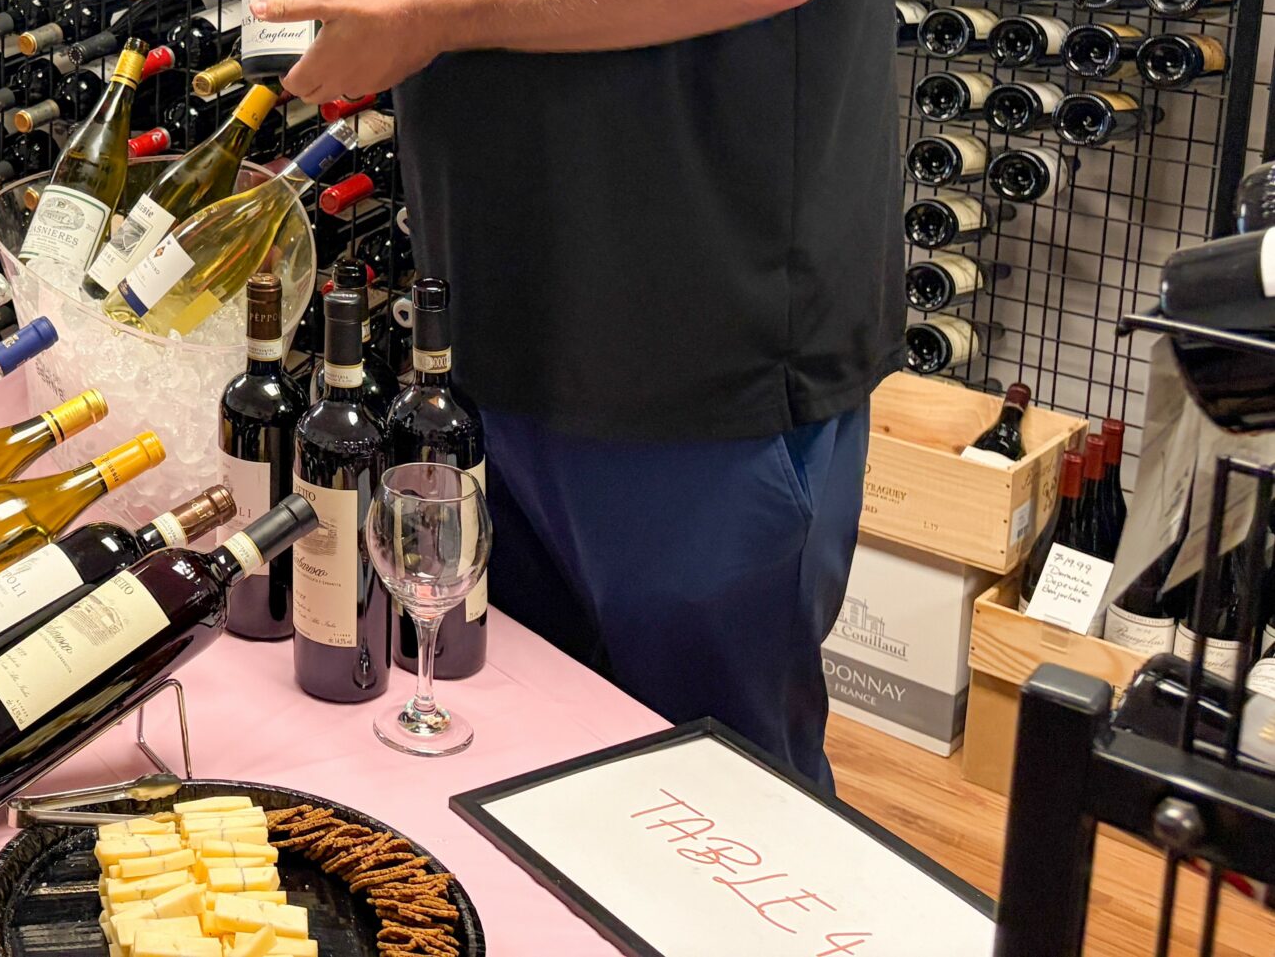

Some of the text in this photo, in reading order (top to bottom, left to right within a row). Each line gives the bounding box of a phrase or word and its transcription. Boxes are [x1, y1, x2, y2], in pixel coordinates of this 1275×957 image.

[259, 27, 307, 43] England
[841, 625, 906, 657] Couillaud
[822, 658, 906, 702] DONNAY
[835, 682, 877, 706] FRANCE
[630, 787, 873, 957] TABLE 4
